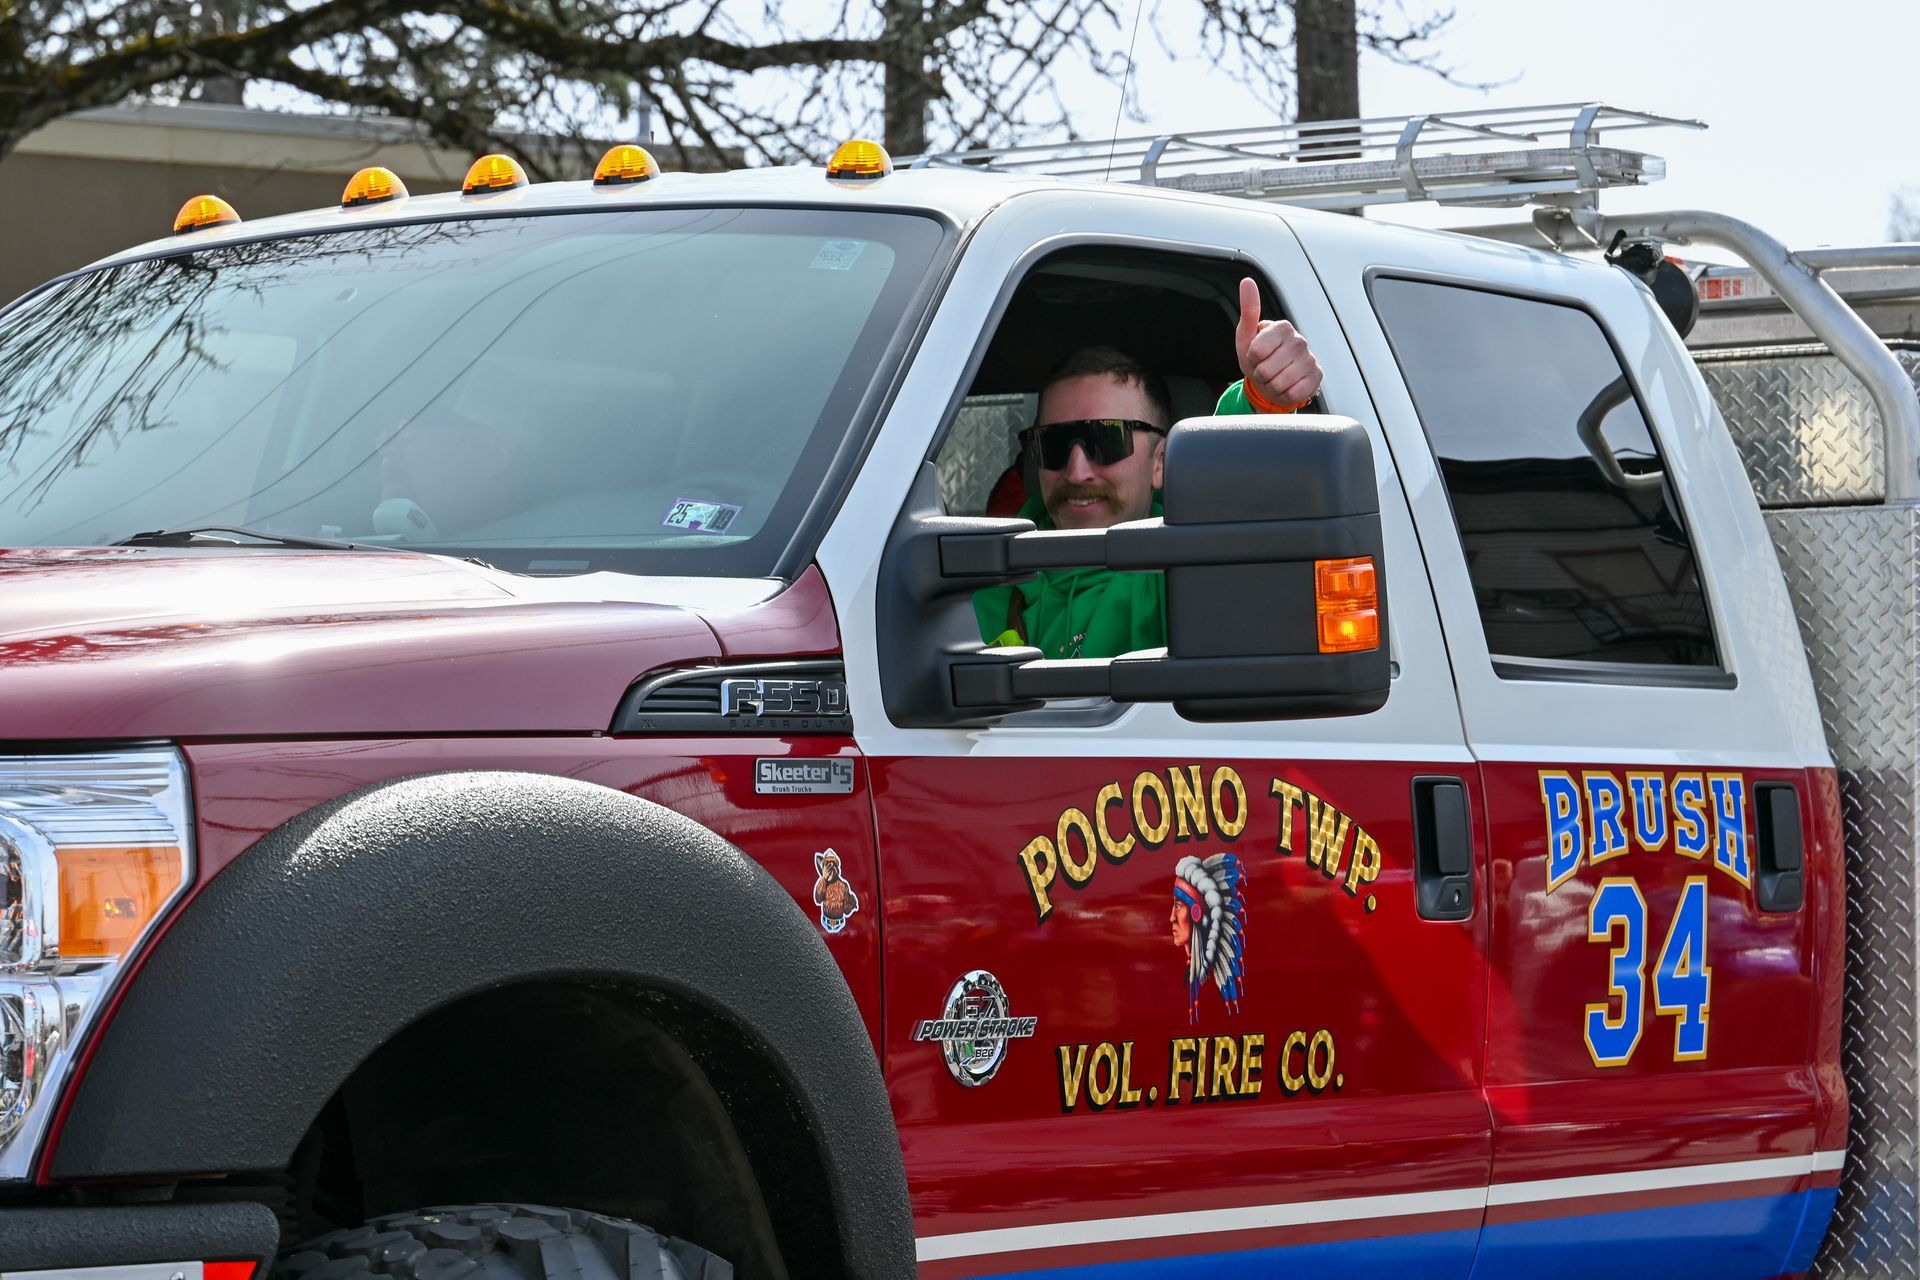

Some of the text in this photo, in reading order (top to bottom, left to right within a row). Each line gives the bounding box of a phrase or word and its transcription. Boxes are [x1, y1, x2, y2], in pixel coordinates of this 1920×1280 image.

[667, 503, 693, 524] 25
[721, 679, 848, 717] F-550
[729, 719, 848, 729] SUPER DUTY
[760, 763, 830, 781] Skeeter
[772, 785, 812, 793] Brush Trucks
[1018, 764, 1382, 923] POCONO TWP.
[1537, 769, 1752, 896] BRUSH
[1583, 875, 1712, 1068] 34
[917, 1017, 1037, 1040] POWER STROKE
[1058, 1028, 1345, 1113] VOL. FIRE CO.
